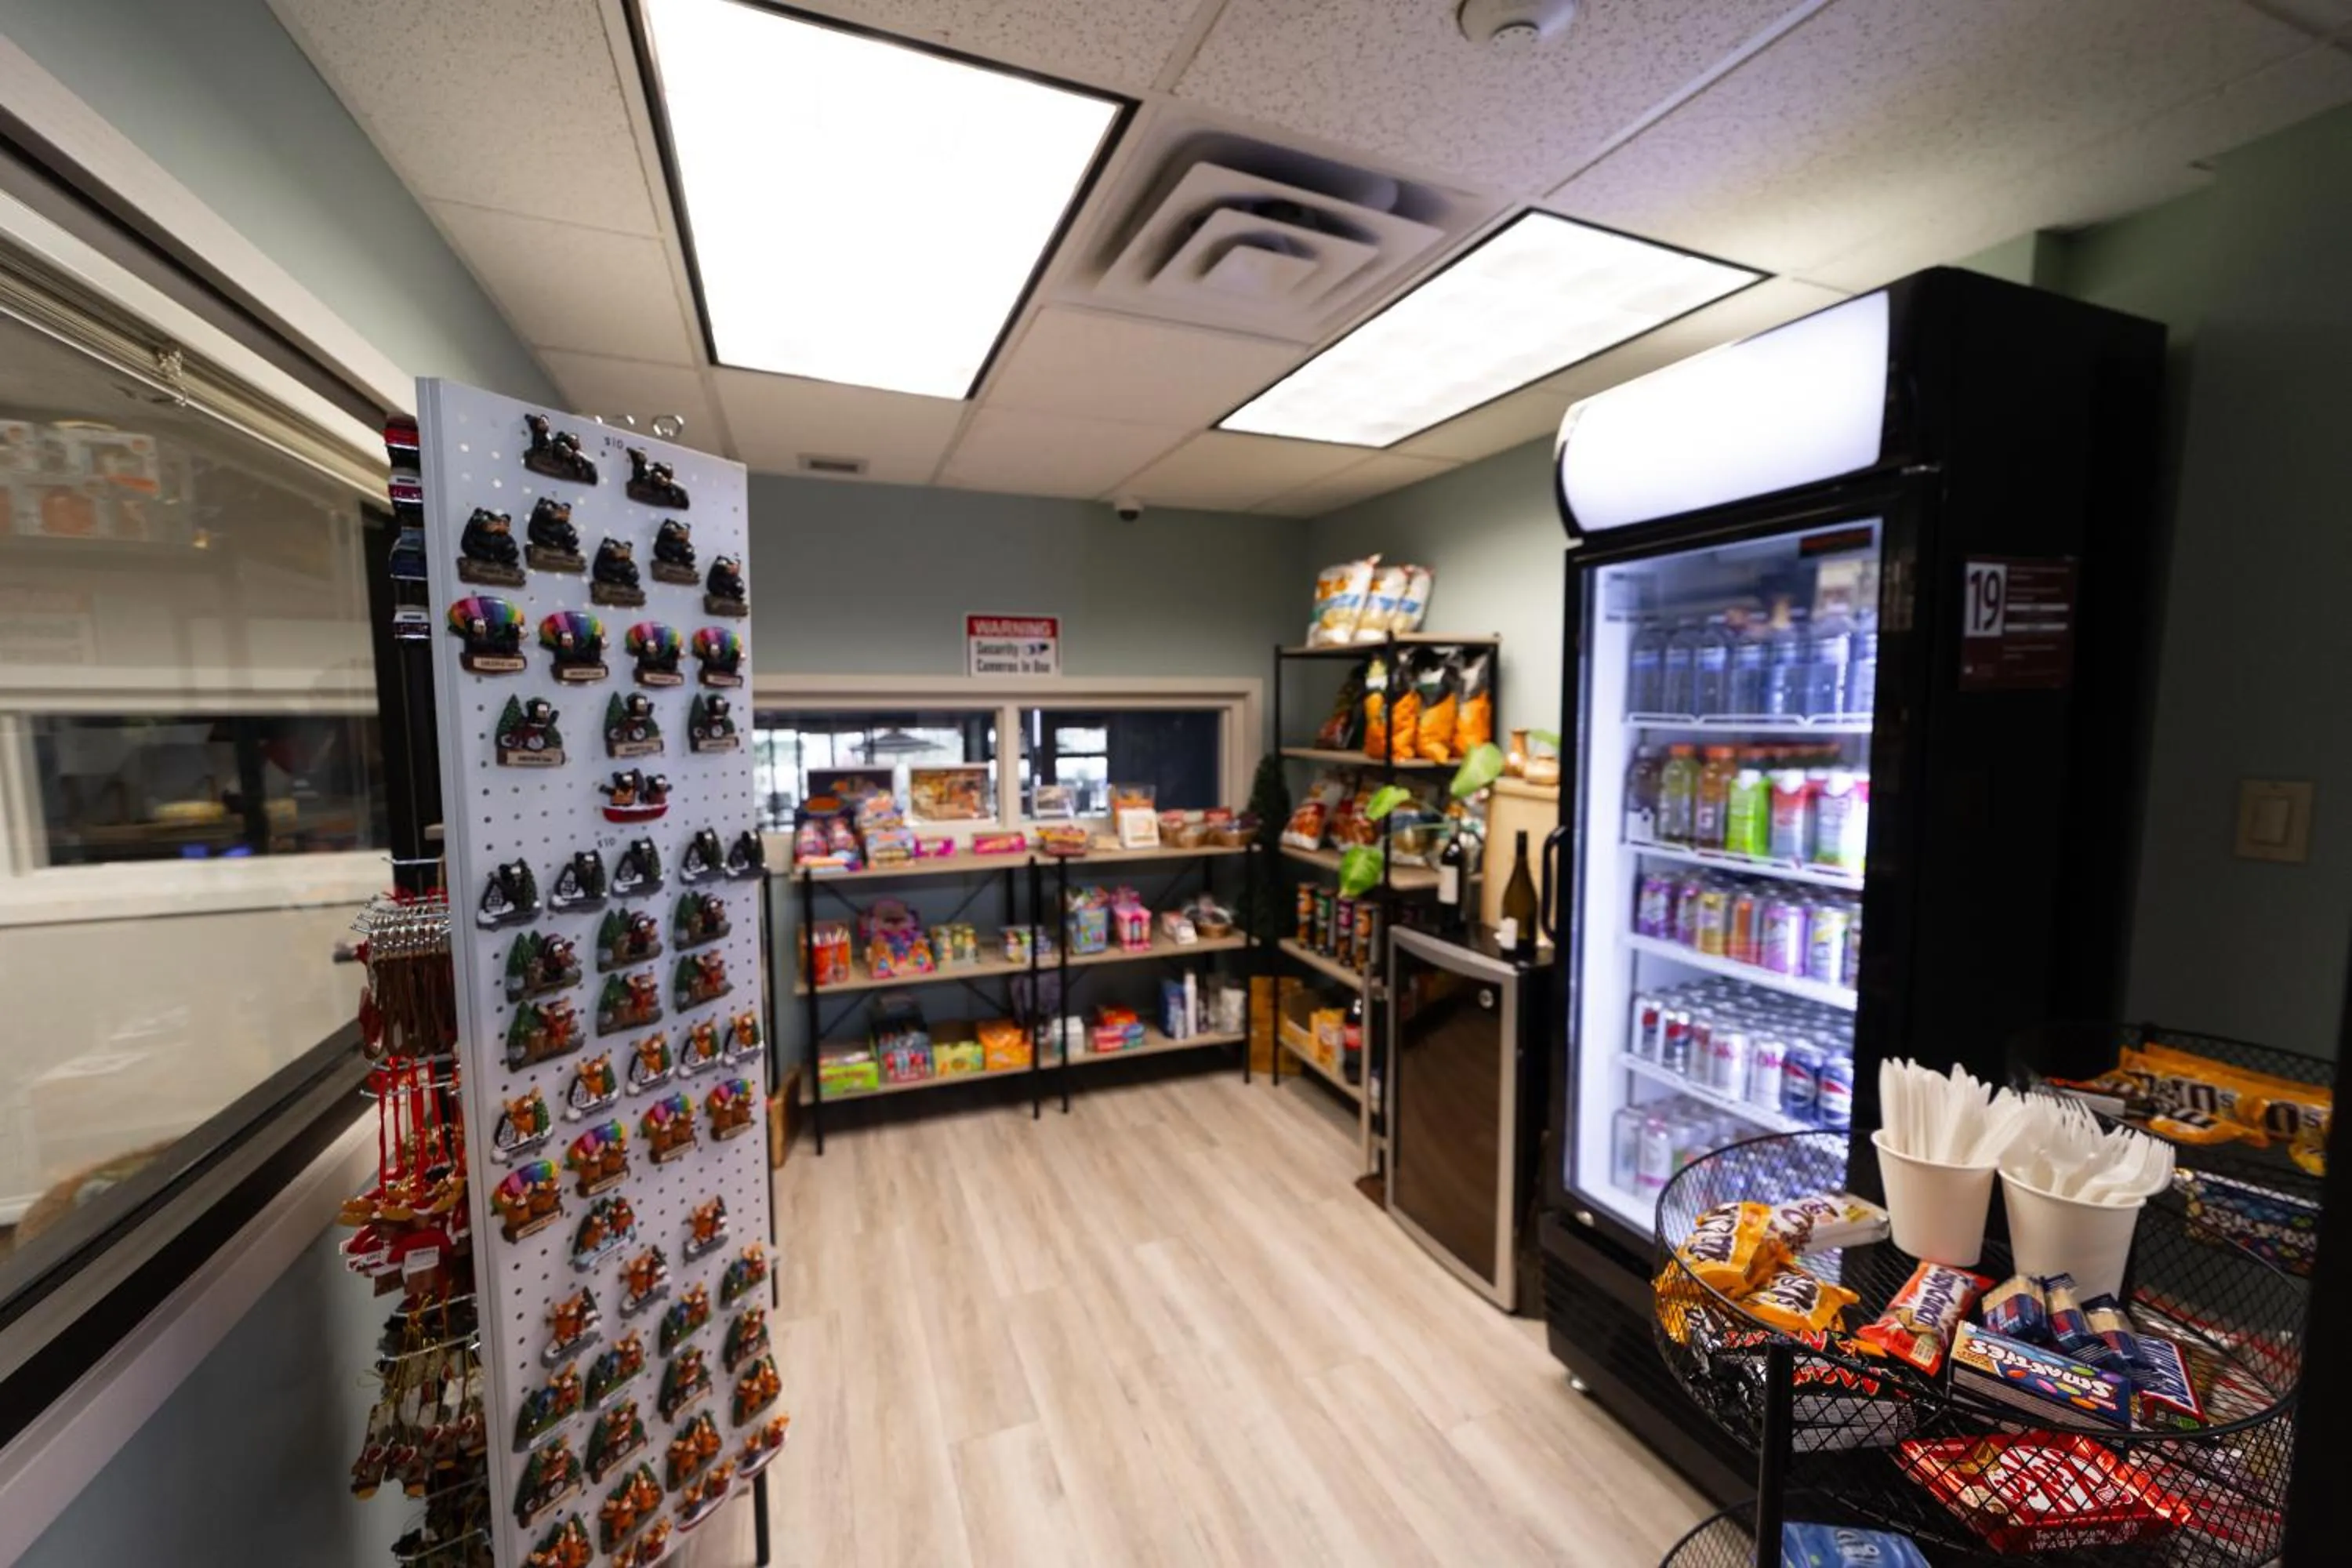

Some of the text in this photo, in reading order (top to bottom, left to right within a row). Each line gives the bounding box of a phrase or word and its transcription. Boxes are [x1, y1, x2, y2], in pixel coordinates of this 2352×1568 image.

[1969, 569, 2002, 632] 19
[972, 619, 1053, 637] WARNING
[975, 640, 1020, 657] Security
[975, 658, 1019, 673] Cameras
[1033, 659, 1051, 673] Use
